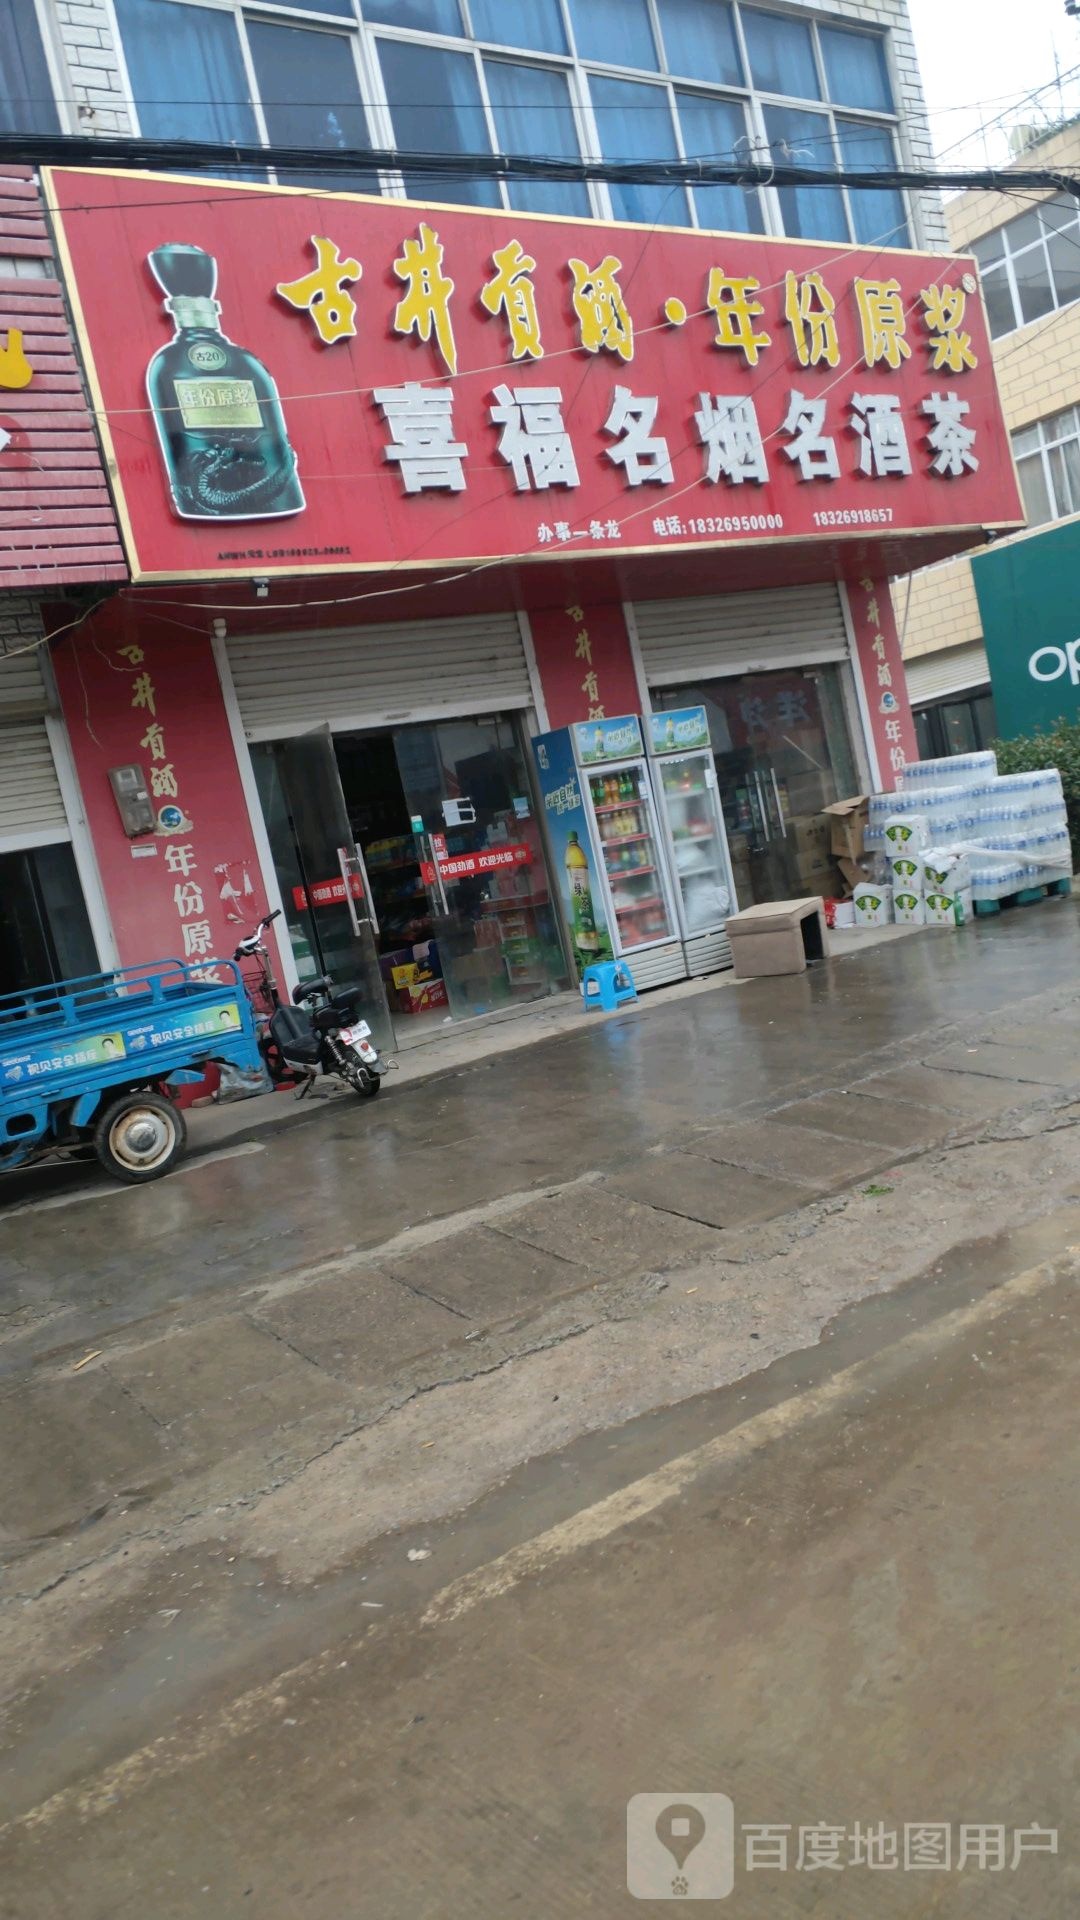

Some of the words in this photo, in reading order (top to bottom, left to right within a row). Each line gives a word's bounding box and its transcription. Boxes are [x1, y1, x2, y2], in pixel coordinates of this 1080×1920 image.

[374, 382, 980, 493] 喜福名烟名酒茶
[537, 520, 622, 542] 办事一条龙
[813, 508, 893, 527] 18326918657
[439, 858, 475, 876] 中国劲酒
[479, 851, 513, 868] 欢迎光临
